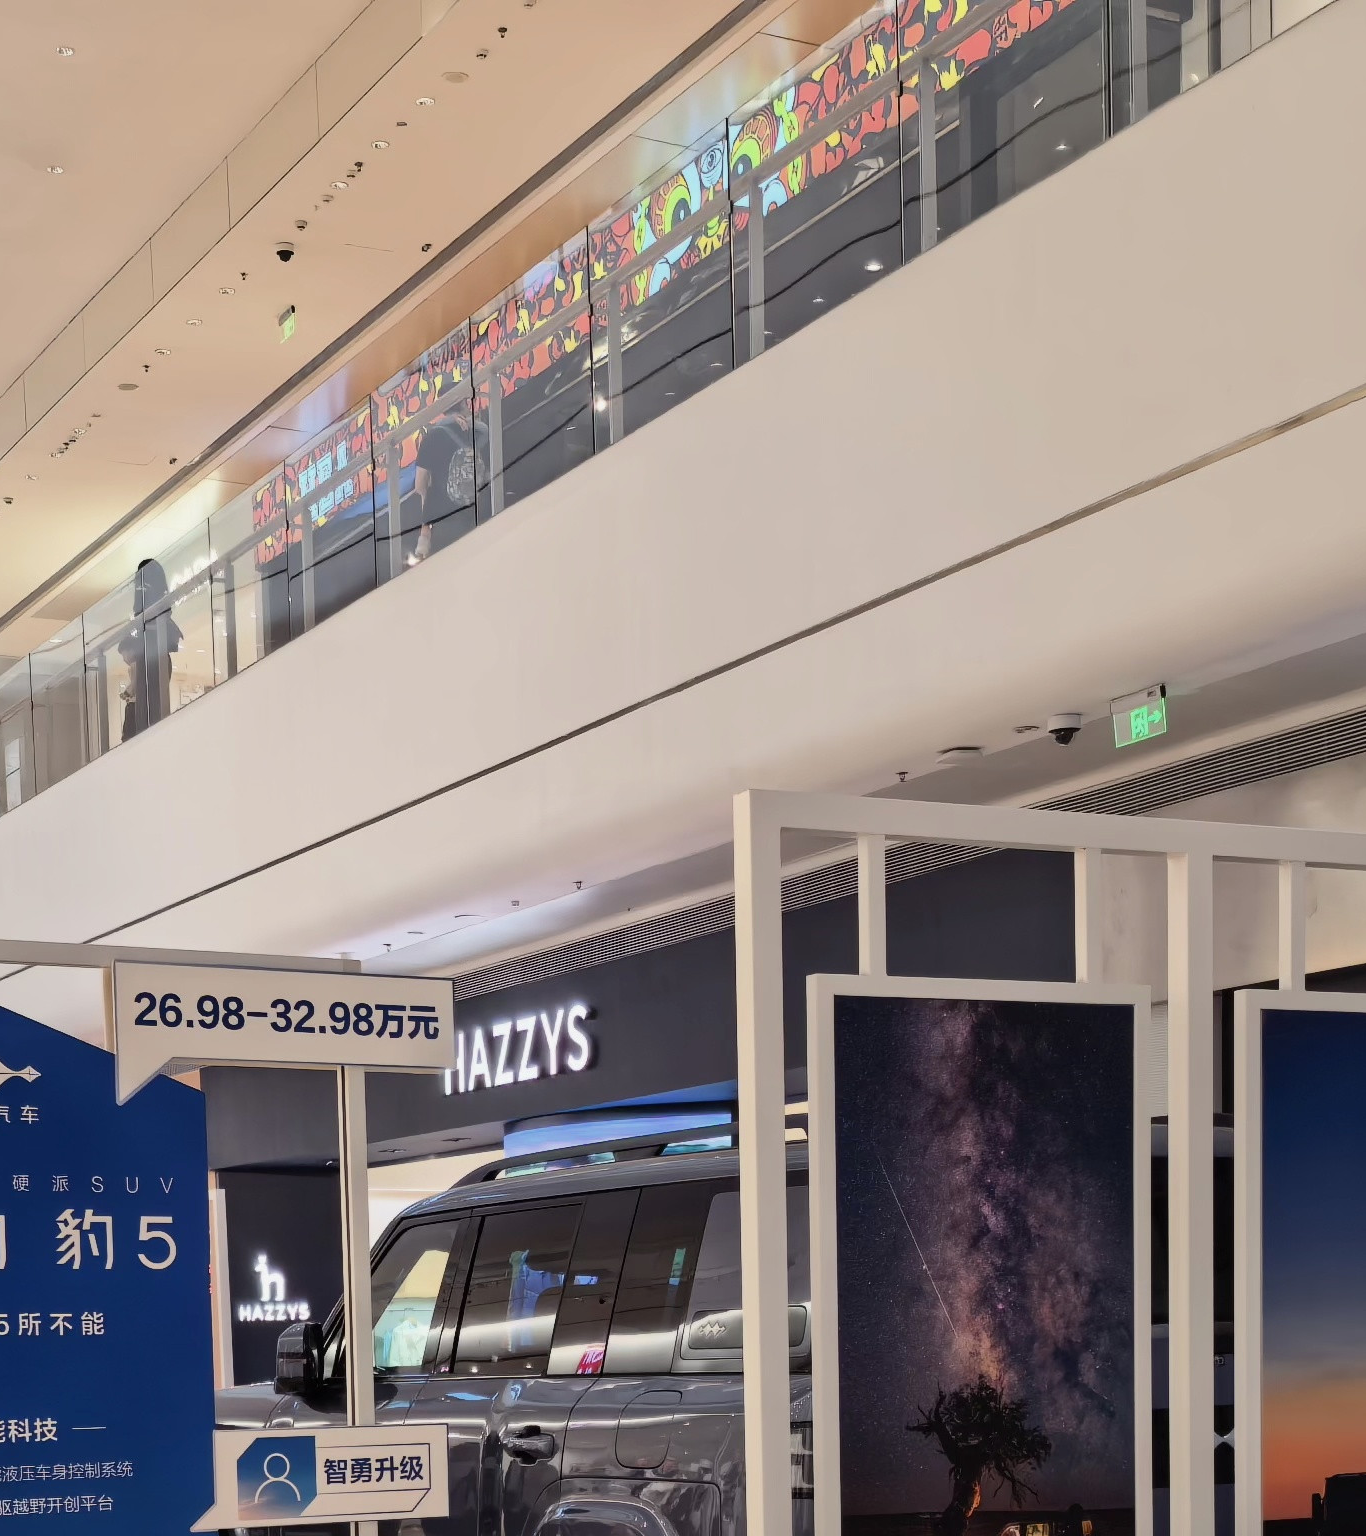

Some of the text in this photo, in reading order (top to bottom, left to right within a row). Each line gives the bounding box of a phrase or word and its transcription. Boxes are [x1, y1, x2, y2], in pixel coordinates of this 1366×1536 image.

[134, 991, 440, 1041] 26.98-32.98万元
[444, 1004, 589, 1095] HAZZYS
[56, 1208, 178, 1270] 豹5
[238, 1301, 311, 1322] HAZZYS
[324, 1455, 424, 1485] 智勇升级
